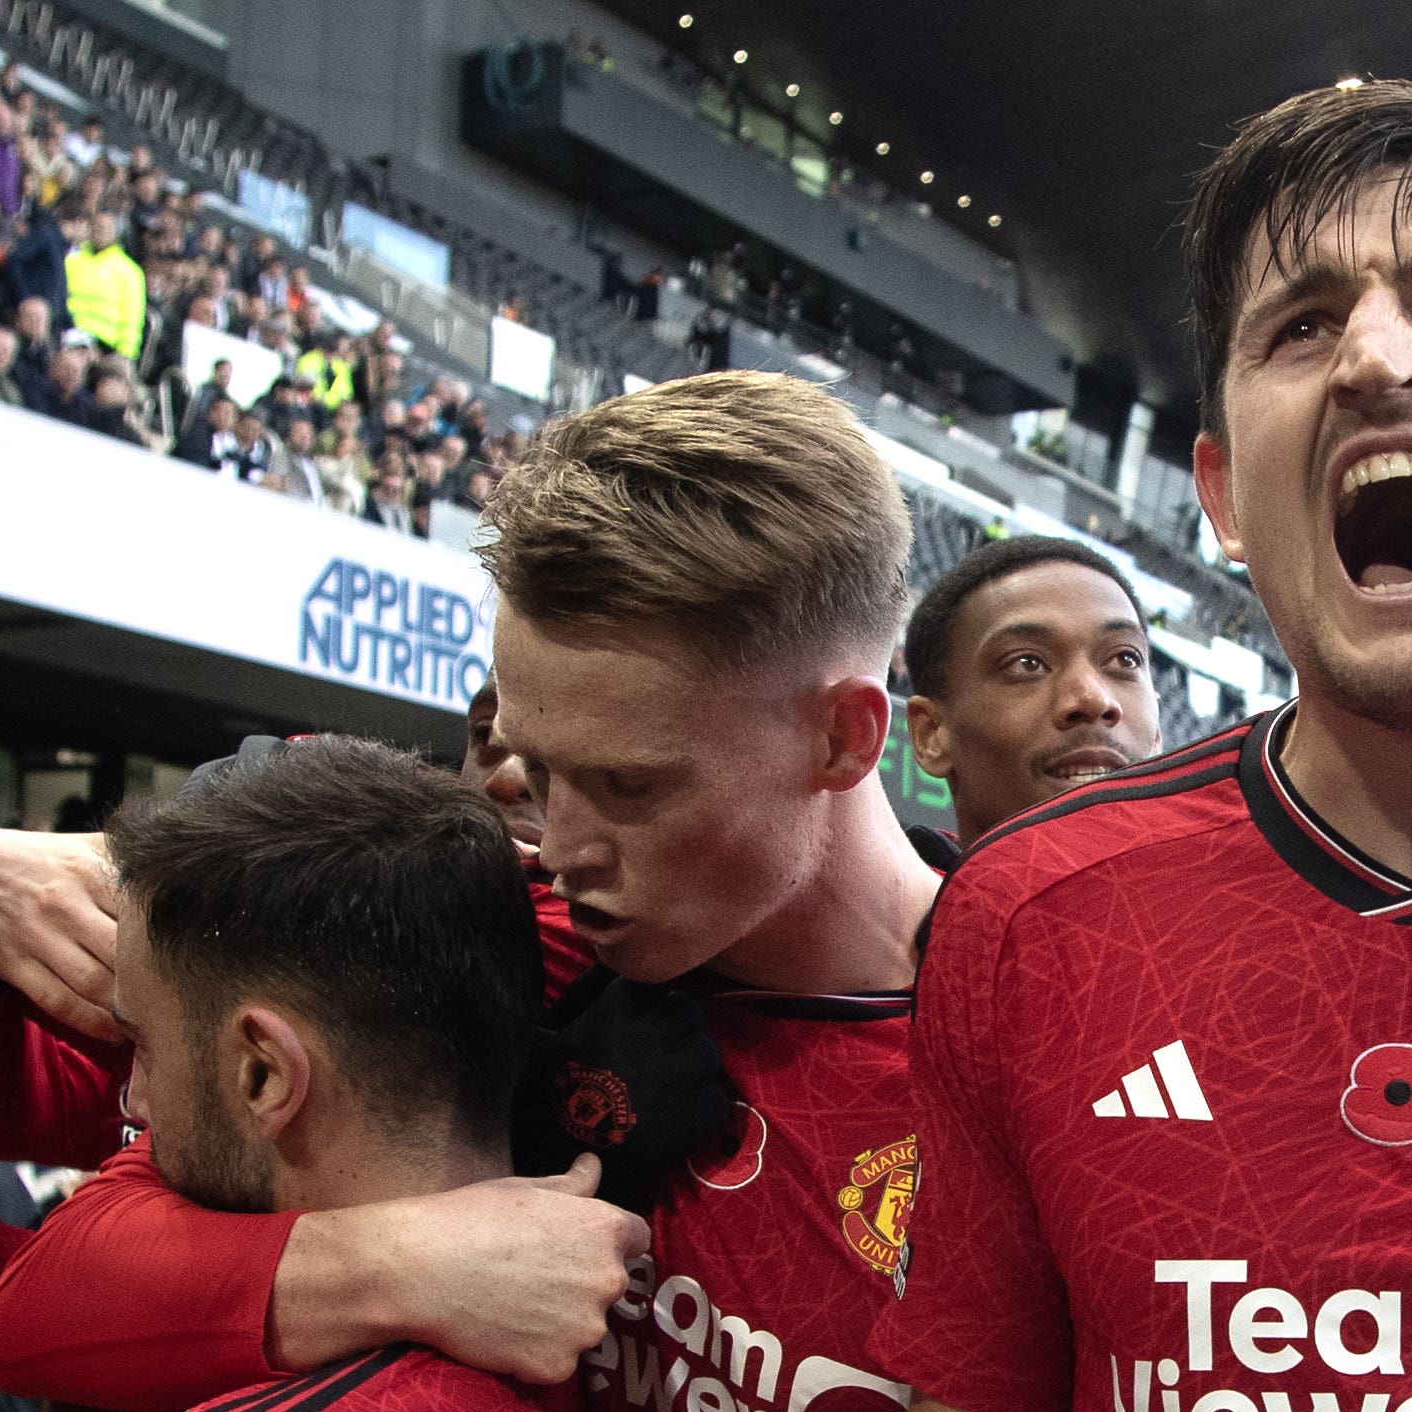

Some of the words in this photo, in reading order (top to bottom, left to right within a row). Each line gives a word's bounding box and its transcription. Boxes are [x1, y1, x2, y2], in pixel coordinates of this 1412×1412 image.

[303, 556, 473, 647] APPLIED
[298, 607, 489, 701] NUTRITIO
[614, 1253, 783, 1403] eam
